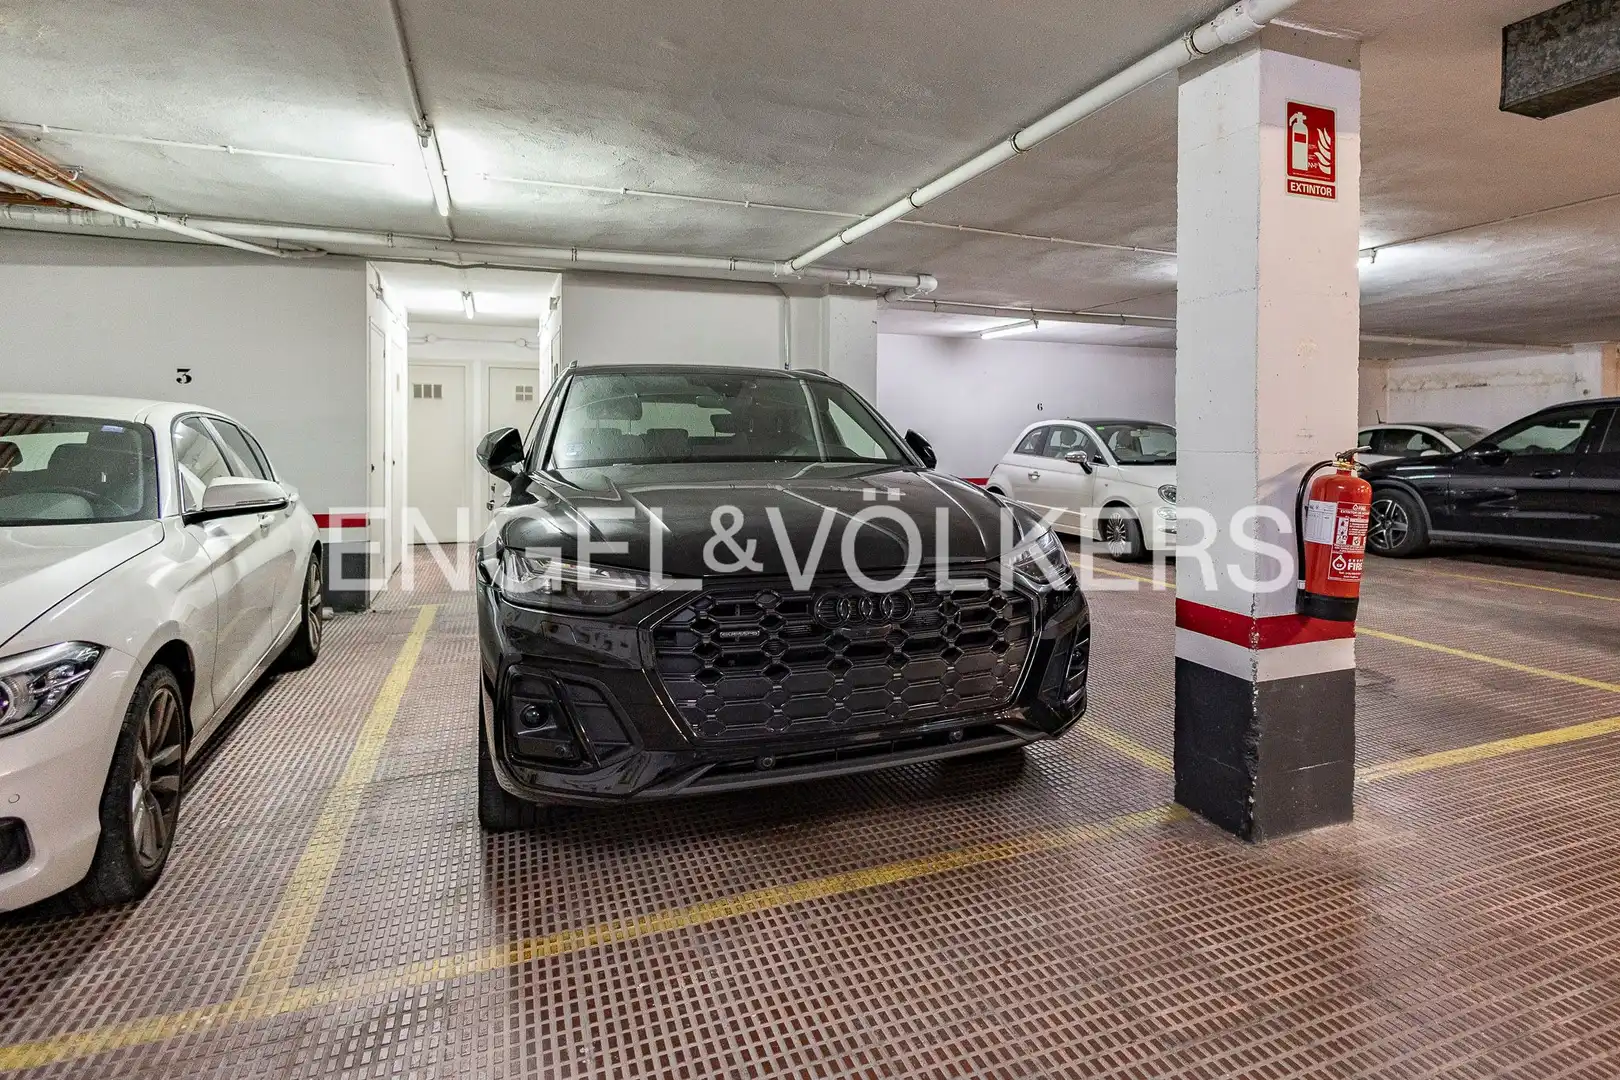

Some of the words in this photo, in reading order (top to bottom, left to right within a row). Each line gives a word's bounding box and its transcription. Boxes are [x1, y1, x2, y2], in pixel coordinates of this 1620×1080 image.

[1290, 182, 1332, 196] EXTINTOR
[176, 368, 192, 384] 3
[1036, 403, 1043, 411] 6
